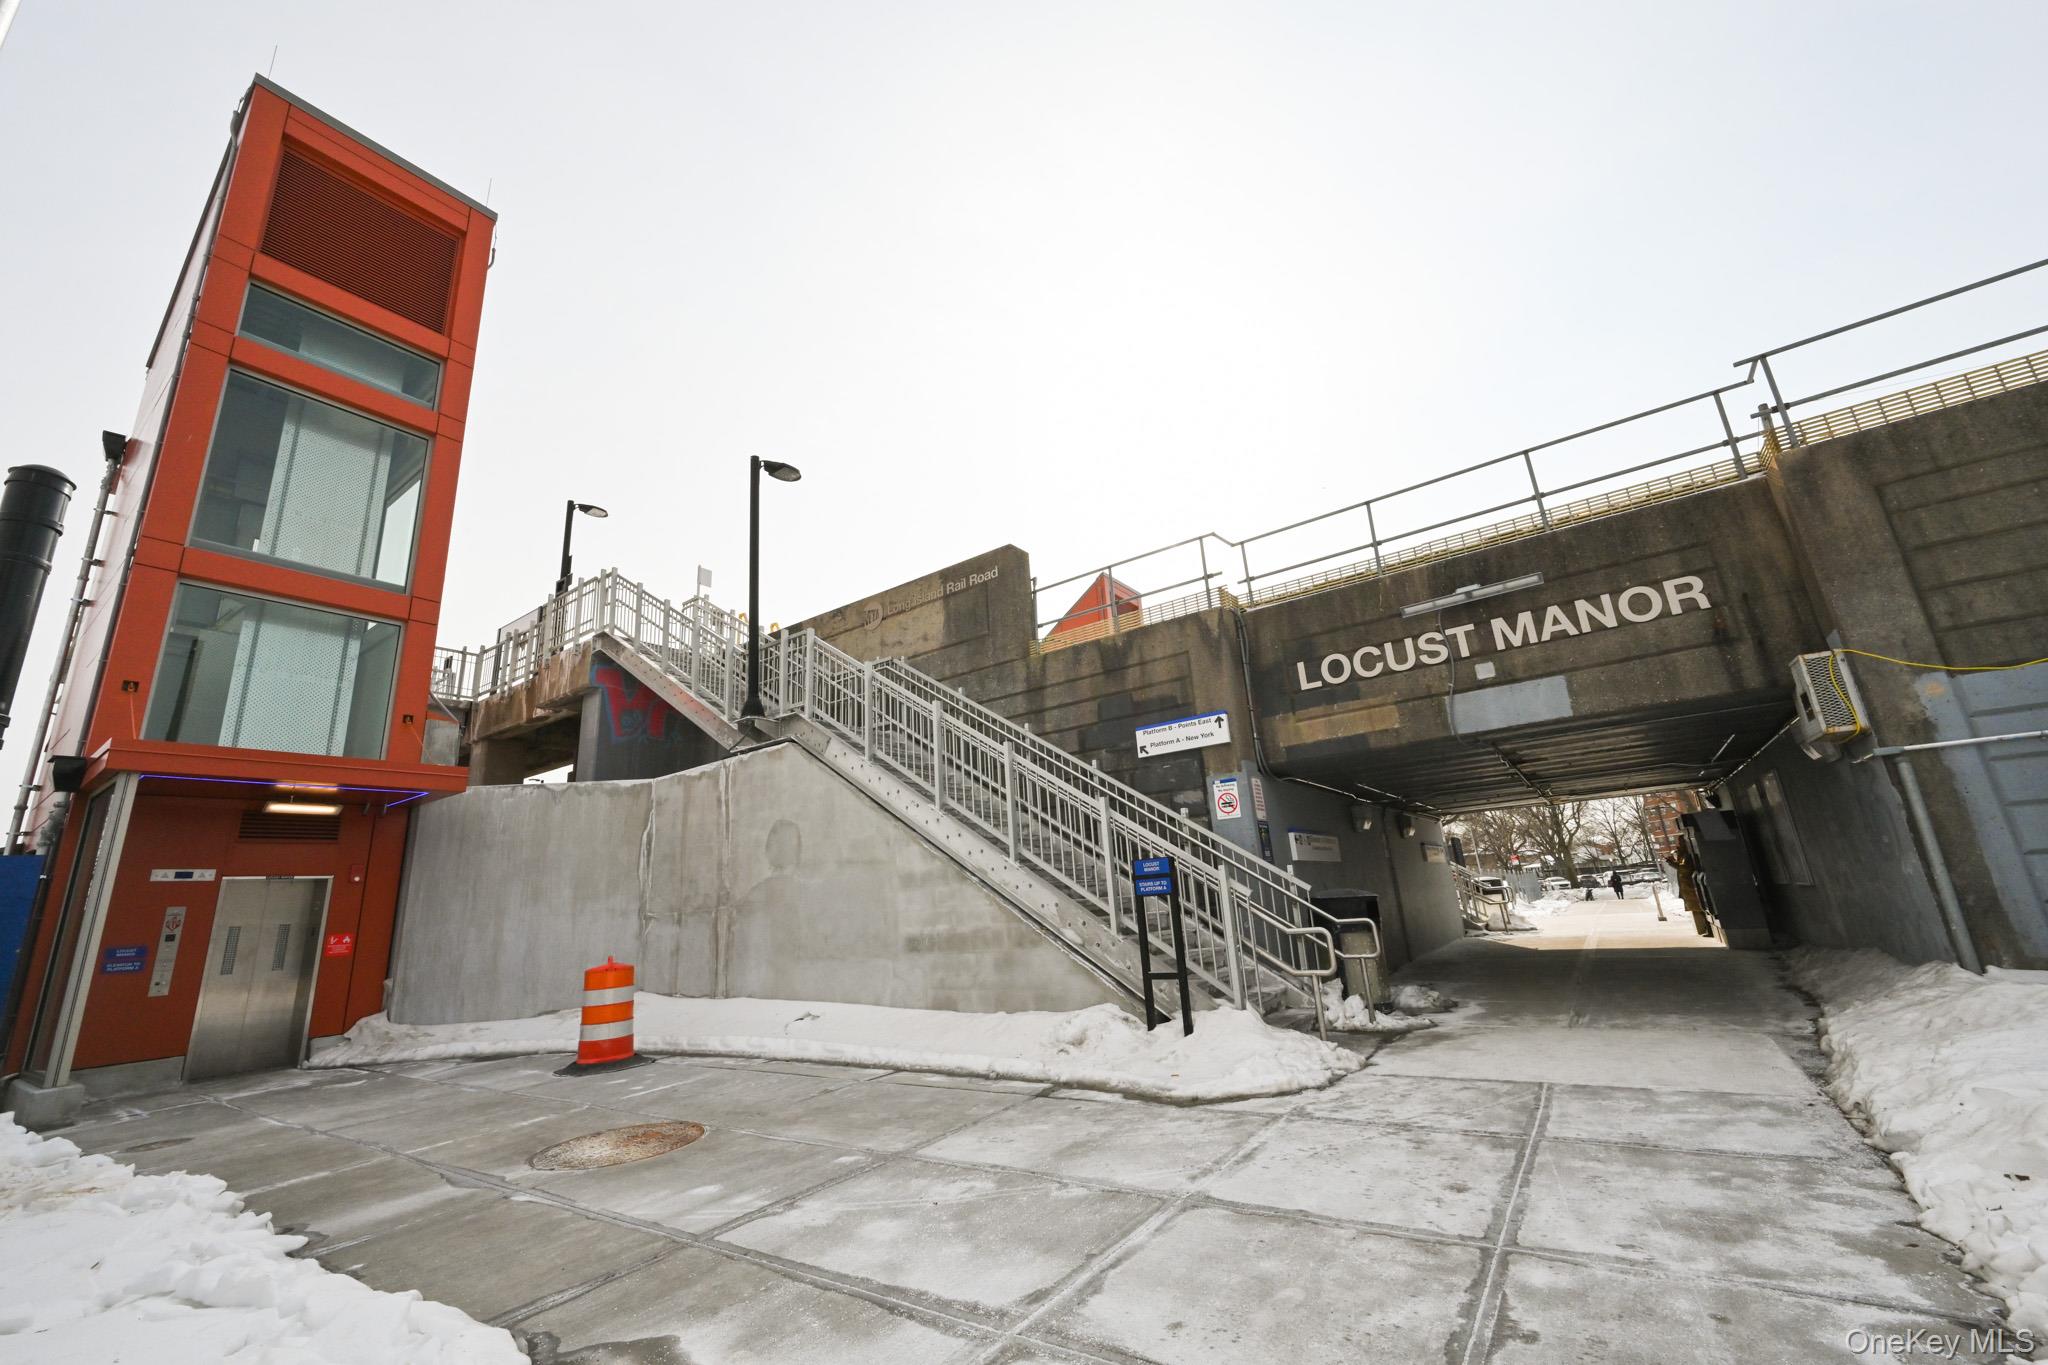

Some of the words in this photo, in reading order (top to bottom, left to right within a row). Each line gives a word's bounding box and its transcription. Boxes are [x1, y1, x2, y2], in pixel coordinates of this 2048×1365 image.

[887, 600, 911, 615] Long
[912, 585, 944, 605] Island
[946, 578, 966, 595] Rail
[969, 566, 999, 587] Road
[1297, 623, 1475, 691] LOCUST
[1490, 575, 1712, 651] MANOR
[1142, 727, 1167, 736] Platform
[1178, 720, 1197, 729] Points
[1198, 717, 1212, 725] East
[1150, 739, 1175, 748] Platform
[1200, 731, 1214, 739] York
